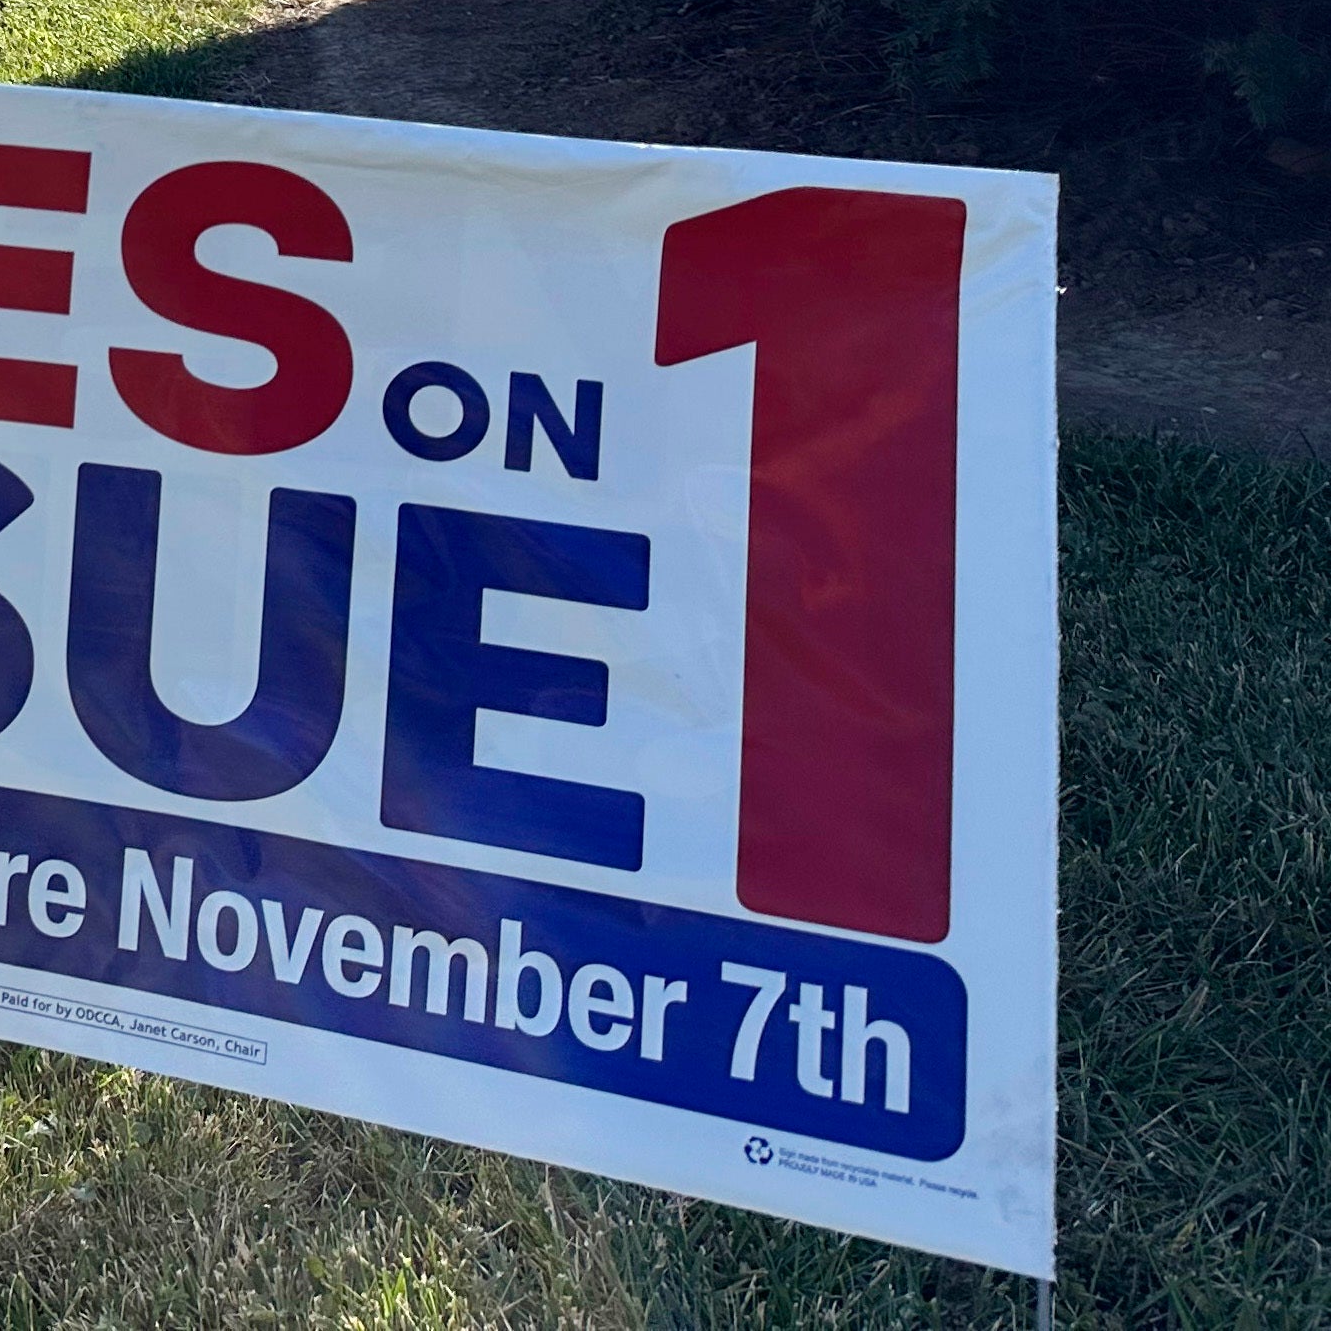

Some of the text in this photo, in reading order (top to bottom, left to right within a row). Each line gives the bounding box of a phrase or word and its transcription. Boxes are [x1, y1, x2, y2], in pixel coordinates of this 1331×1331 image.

[382, 361, 604, 482] ON
[654, 186, 968, 945] 1
[1, 992, 261, 1057] Paid for by ODCCA, Janet Carson, Chair
[118, 845, 688, 1064] November
[708, 963, 915, 1116] 7th
